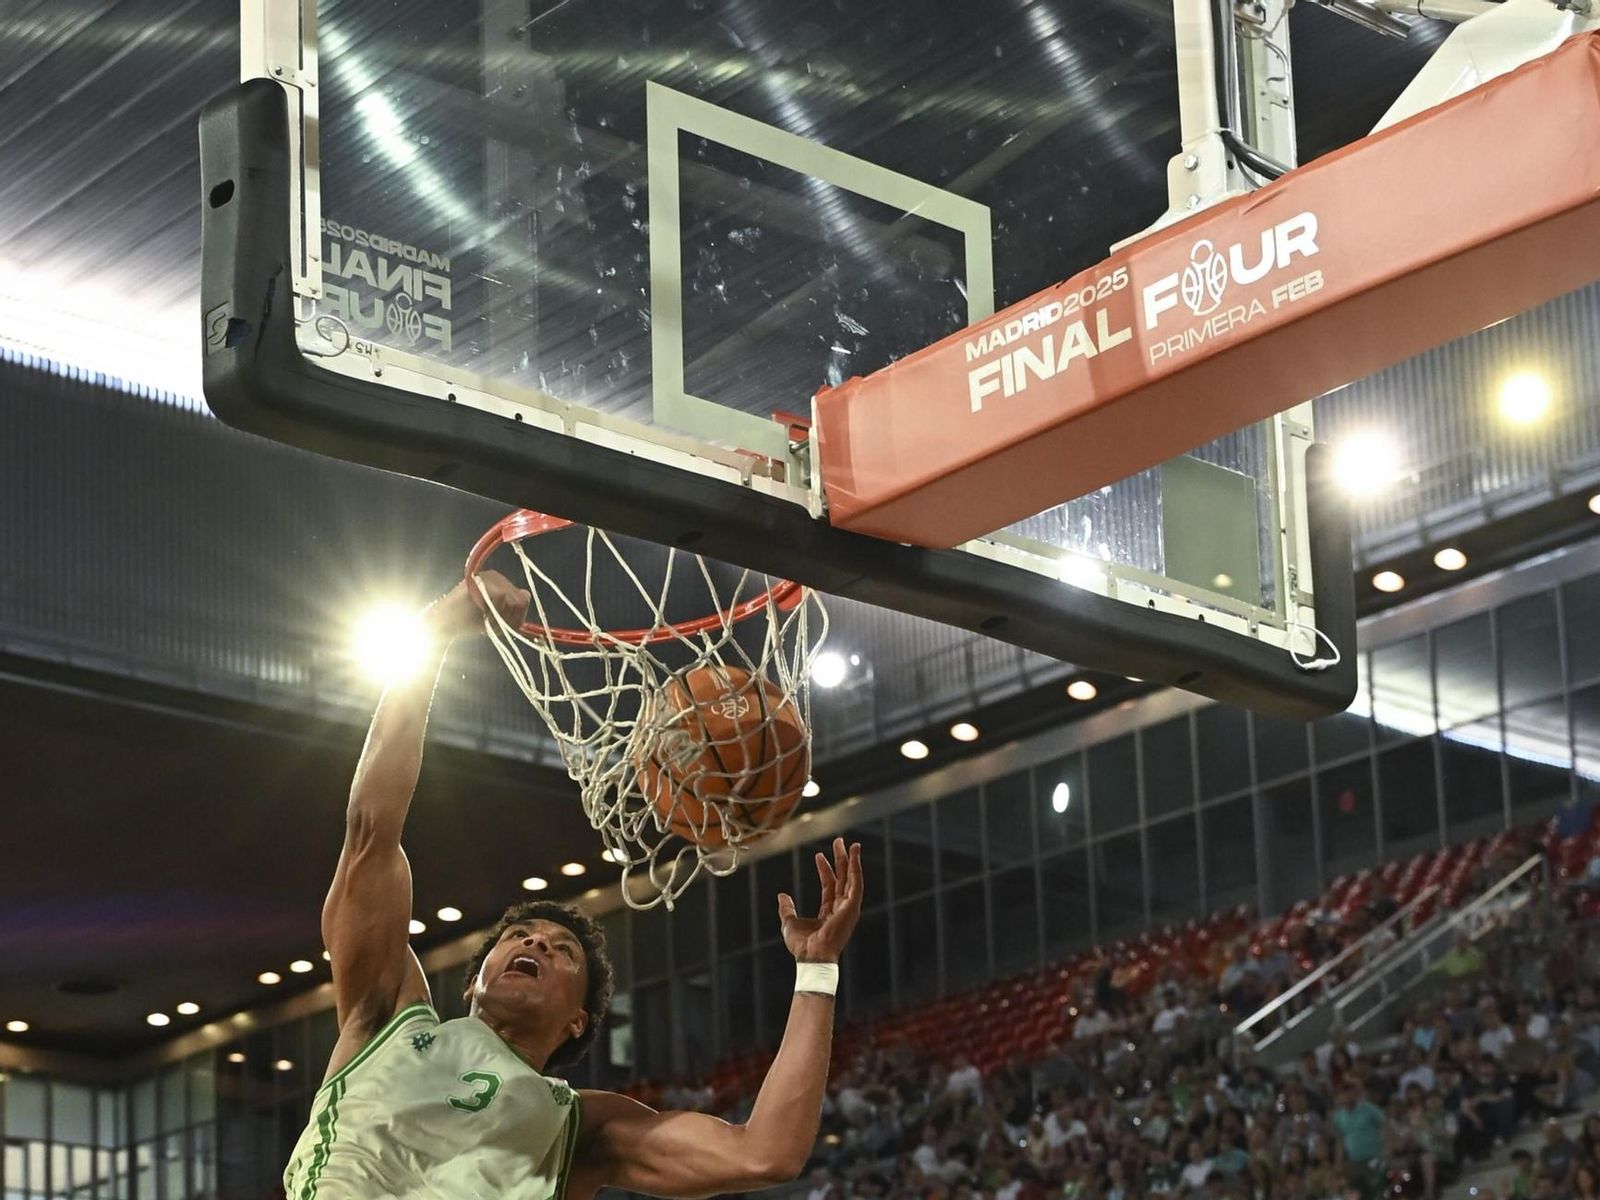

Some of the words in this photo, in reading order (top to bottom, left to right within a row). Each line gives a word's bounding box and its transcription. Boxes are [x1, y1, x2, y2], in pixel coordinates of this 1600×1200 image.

[965, 267, 1129, 363] MADRID2025
[968, 309, 1132, 413] FINAL
[1149, 298, 1266, 366] PRIMERA
[1271, 269, 1324, 310] FEB
[447, 1069, 504, 1113] 3
